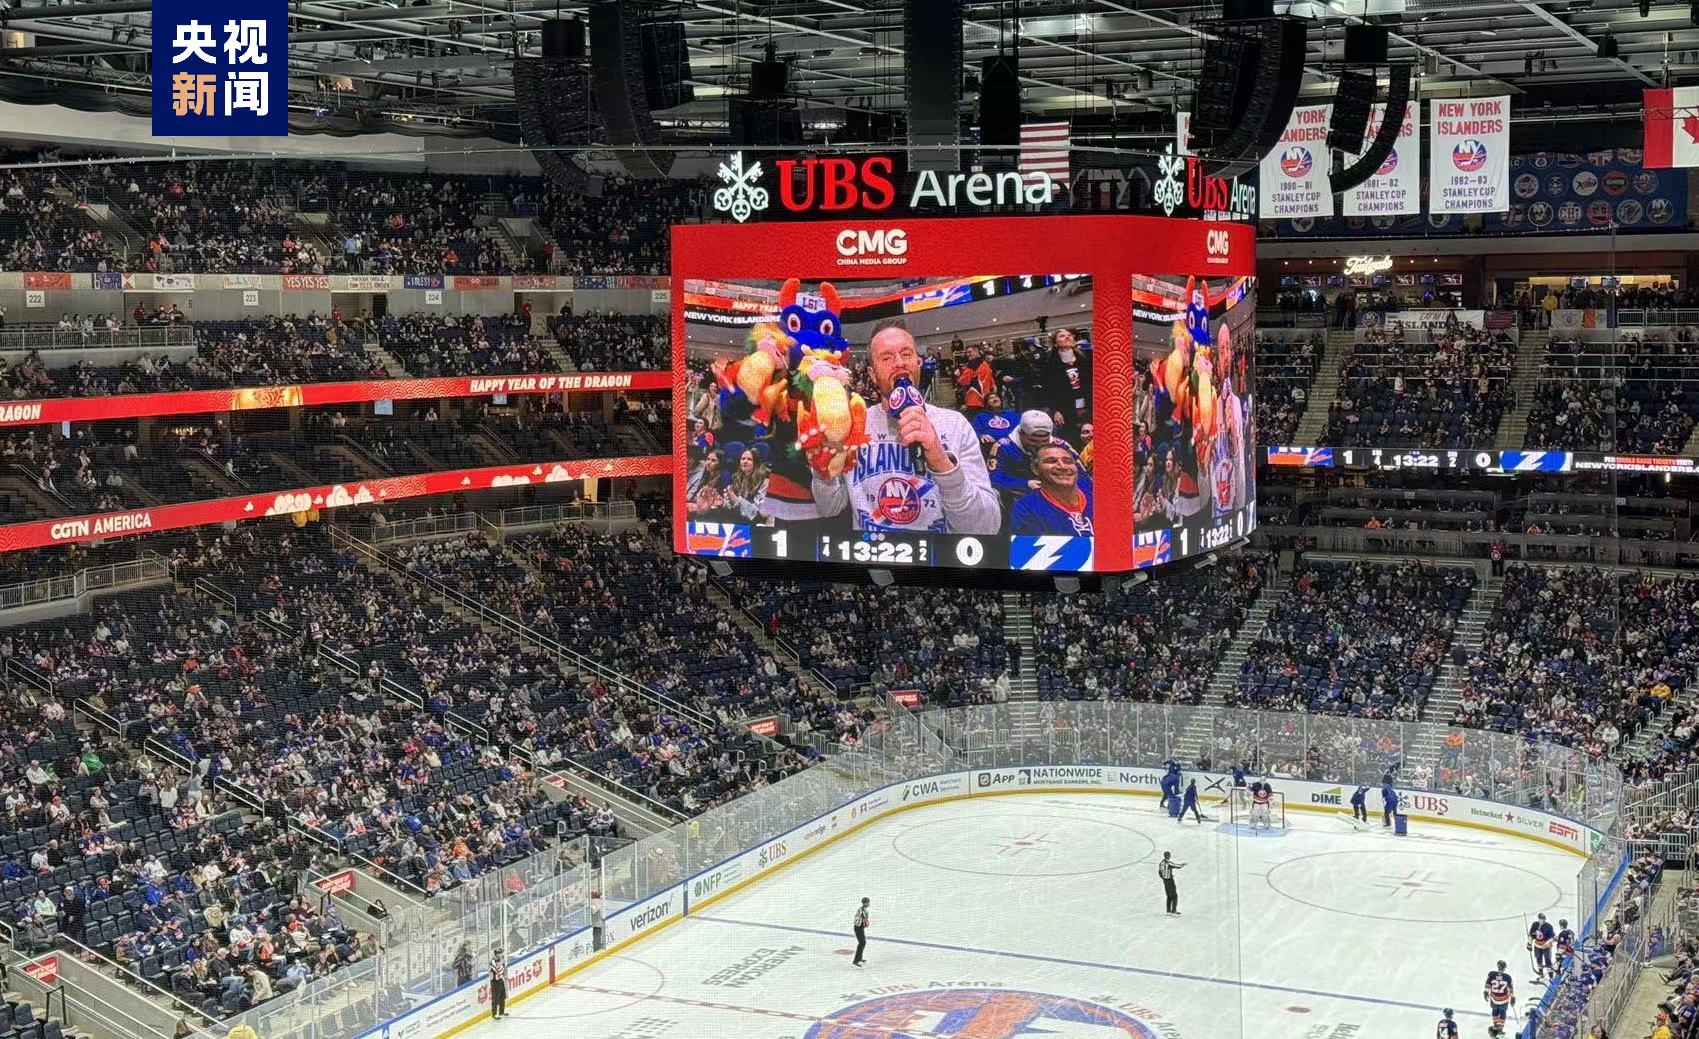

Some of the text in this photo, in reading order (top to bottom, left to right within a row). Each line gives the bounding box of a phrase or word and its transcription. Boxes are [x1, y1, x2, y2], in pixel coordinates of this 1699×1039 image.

[1439, 101, 1502, 117] NEW YORK
[1296, 110, 1326, 124] YORK
[1438, 119, 1503, 135] ISLANDERS
[1280, 127, 1328, 142] ANDERS
[776, 157, 895, 211] UBS
[910, 170, 1052, 207] Arena
[1187, 157, 1228, 211] UBS
[1230, 175, 1256, 214] Arena
[1272, 192, 1320, 202] STANLEY CUP
[1356, 190, 1406, 200] STANLEY CUP
[1443, 187, 1495, 198] STANLEY CUP
[1274, 204, 1319, 214] CHAMPIONS
[1358, 202, 1404, 212] CHAMPIONS
[1445, 199, 1494, 210] CHAMPIONS
[836, 229, 908, 256] CMG
[1207, 229, 1229, 256] CMG
[286, 276, 330, 288] YES YES YES
[28, 294, 42, 304] 222
[245, 294, 256, 302] 223
[428, 294, 440, 302] 224
[654, 292, 668, 300] 225
[684, 311, 781, 324] NEW YORK ISLANDERS
[1402, 320, 1472, 330] ISLANDRS
[470, 375, 632, 392] HAPPY YEAR OF THE DRAGON
[0, 404, 42, 422] RAGON
[1342, 451, 1352, 464] 1
[1374, 456, 1381, 466] 4
[1393, 454, 1438, 467] 13:22
[1450, 458, 1456, 468] 2
[1476, 453, 1491, 468] 0
[923, 499, 936, 508] 72
[51, 513, 152, 539] CGTN AMERICA
[771, 530, 788, 557] 1
[822, 546, 830, 558] 4
[838, 541, 913, 562] 13:22
[920, 547, 927, 561] 2
[955, 536, 984, 566] 0
[1180, 528, 1188, 556] 1
[1034, 768, 1102, 778] NATIONWIDE
[1120, 772, 1160, 784] North
[912, 782, 938, 796] CWA
[1312, 793, 1342, 805] DIME
[1414, 795, 1448, 813] UBS
[1471, 808, 1544, 828] Heineken SILVER
[1549, 822, 1578, 841] ESPN
[768, 841, 787, 862] UBS
[703, 872, 722, 894] NFP
[630, 902, 669, 931] verizon
[702, 948, 776, 986] EXPRESS
[723, 945, 804, 988] AMERICAN
[928, 980, 1004, 990] Arena
[1490, 979, 1508, 993] 27
